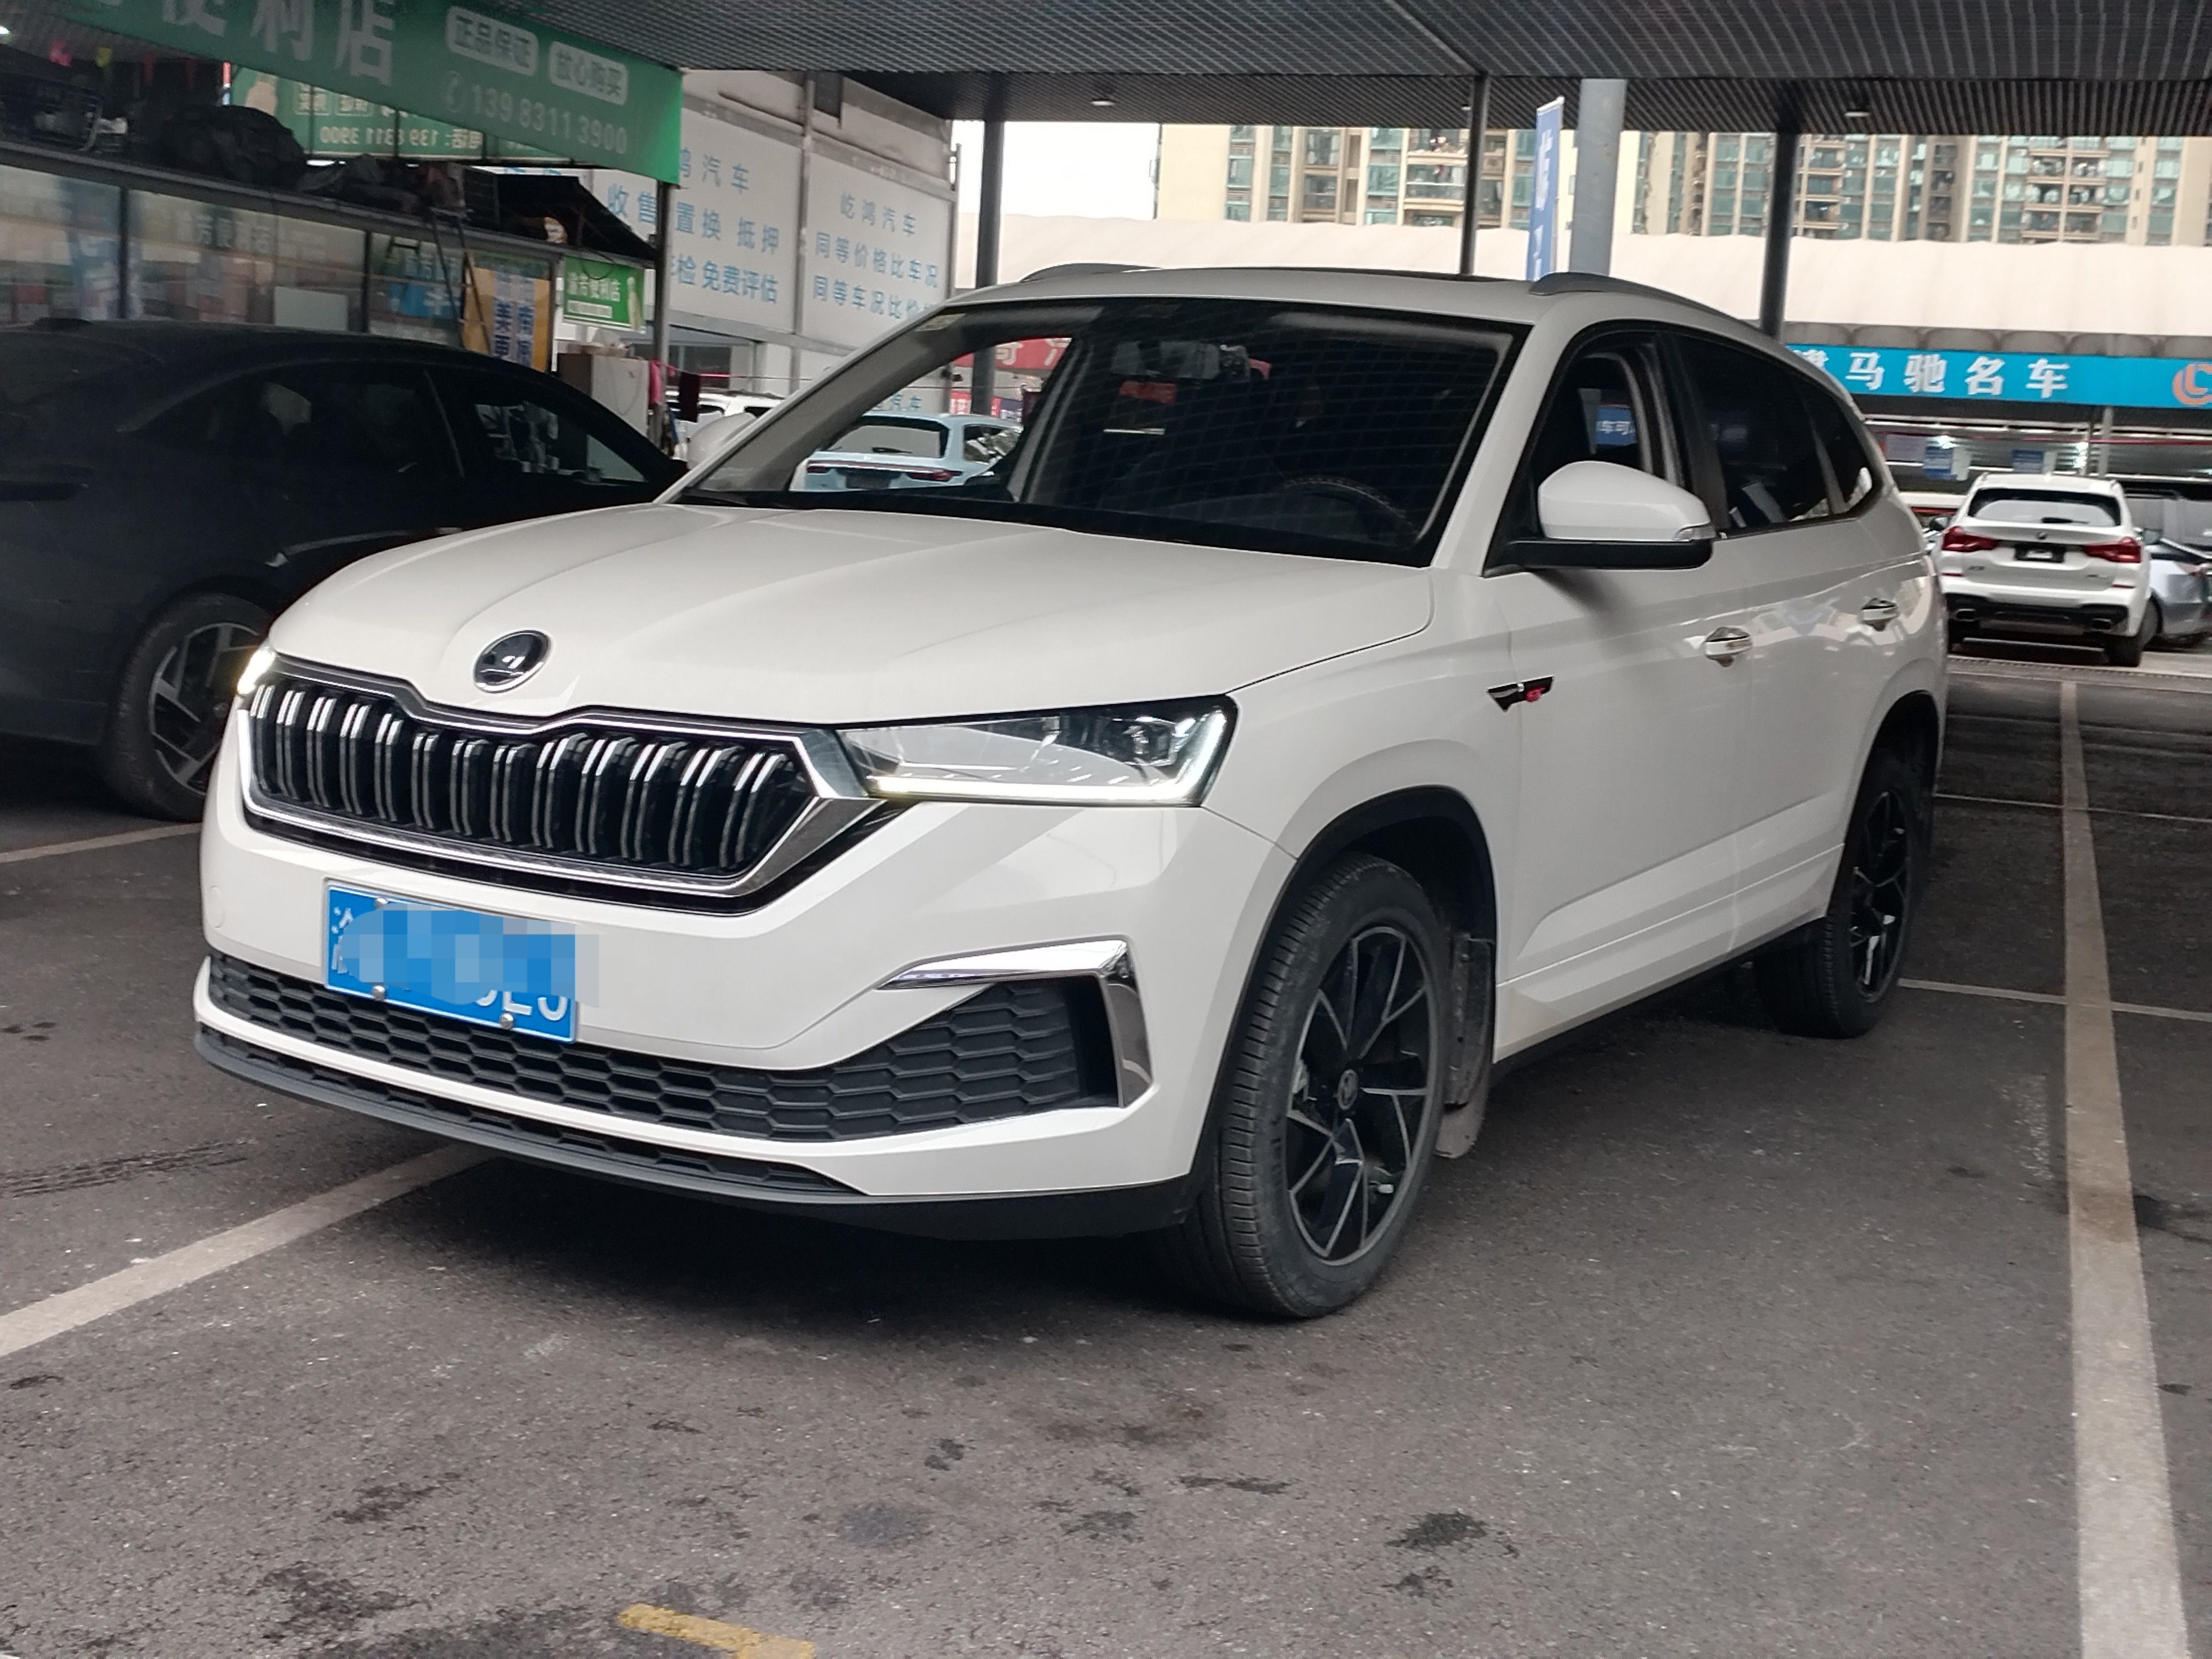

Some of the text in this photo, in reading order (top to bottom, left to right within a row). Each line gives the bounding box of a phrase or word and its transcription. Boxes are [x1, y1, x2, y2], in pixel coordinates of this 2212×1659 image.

[471, 84, 628, 155] 139 8311 3900
[813, 274, 933, 319] 同等车况比价
